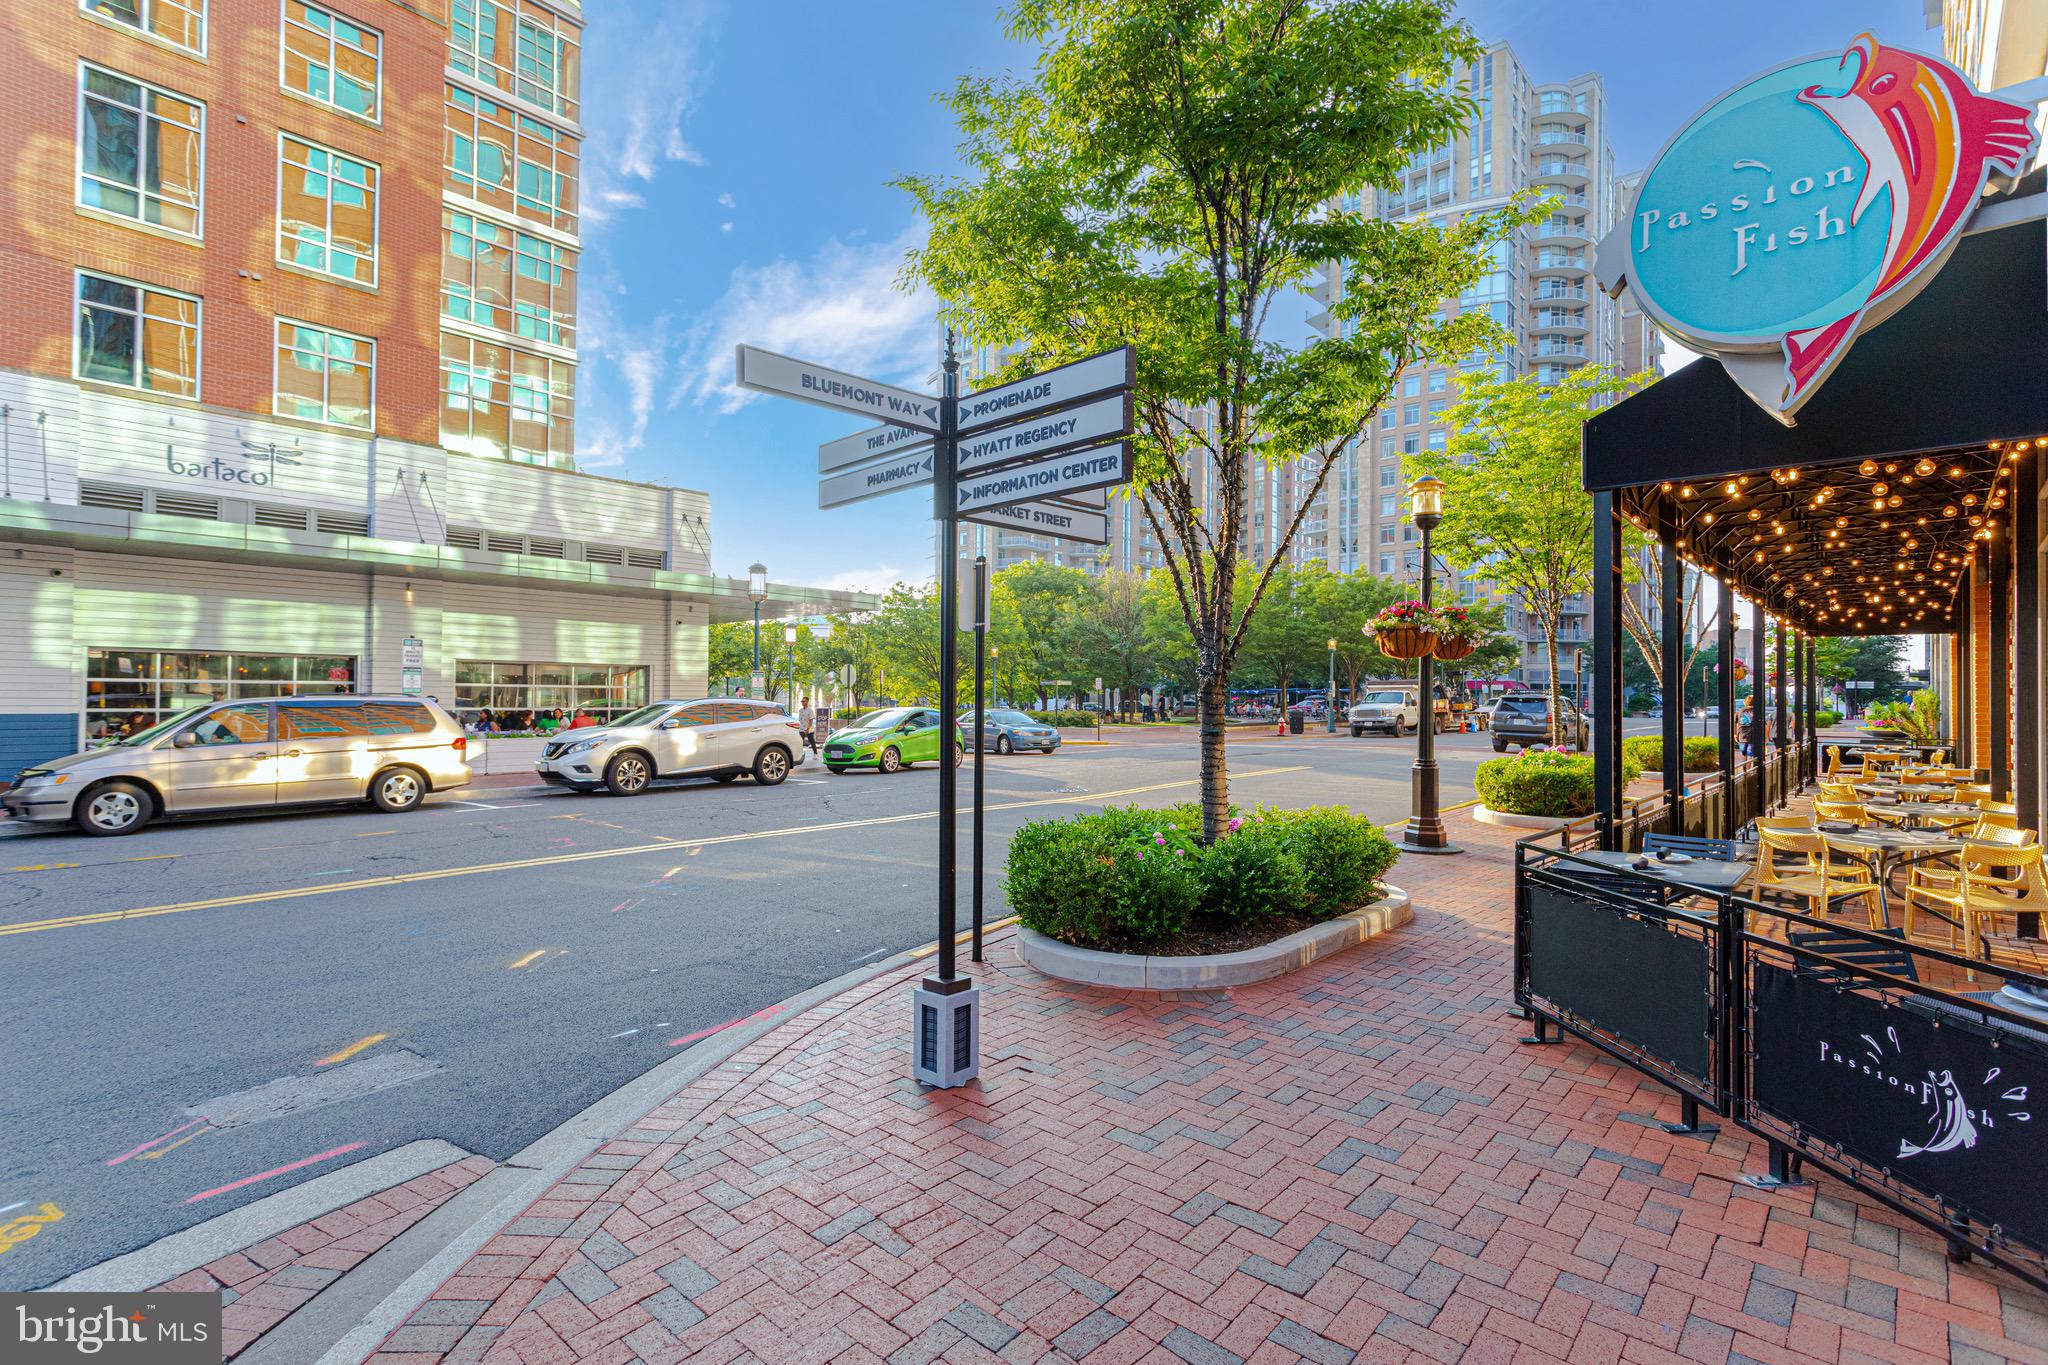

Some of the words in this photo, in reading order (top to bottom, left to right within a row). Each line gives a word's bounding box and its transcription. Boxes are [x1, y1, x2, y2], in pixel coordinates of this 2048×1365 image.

[1639, 164, 1856, 253] Passion
[1730, 205, 1847, 276] Fish
[801, 373, 884, 407] BLUEMONT
[888, 396, 922, 417] WAY
[973, 382, 1052, 417] PROMENADE
[867, 434, 885, 449] THE
[887, 428, 919, 444] AVAN
[973, 436, 1013, 458] HYATT
[1015, 418, 1077, 447] REGENCY
[166, 444, 269, 486] bartaco
[867, 461, 920, 487] PHARMACY
[973, 468, 1059, 500] INFORMATION
[1062, 455, 1119, 480] CENTER
[1033, 511, 1072, 528] STREET
